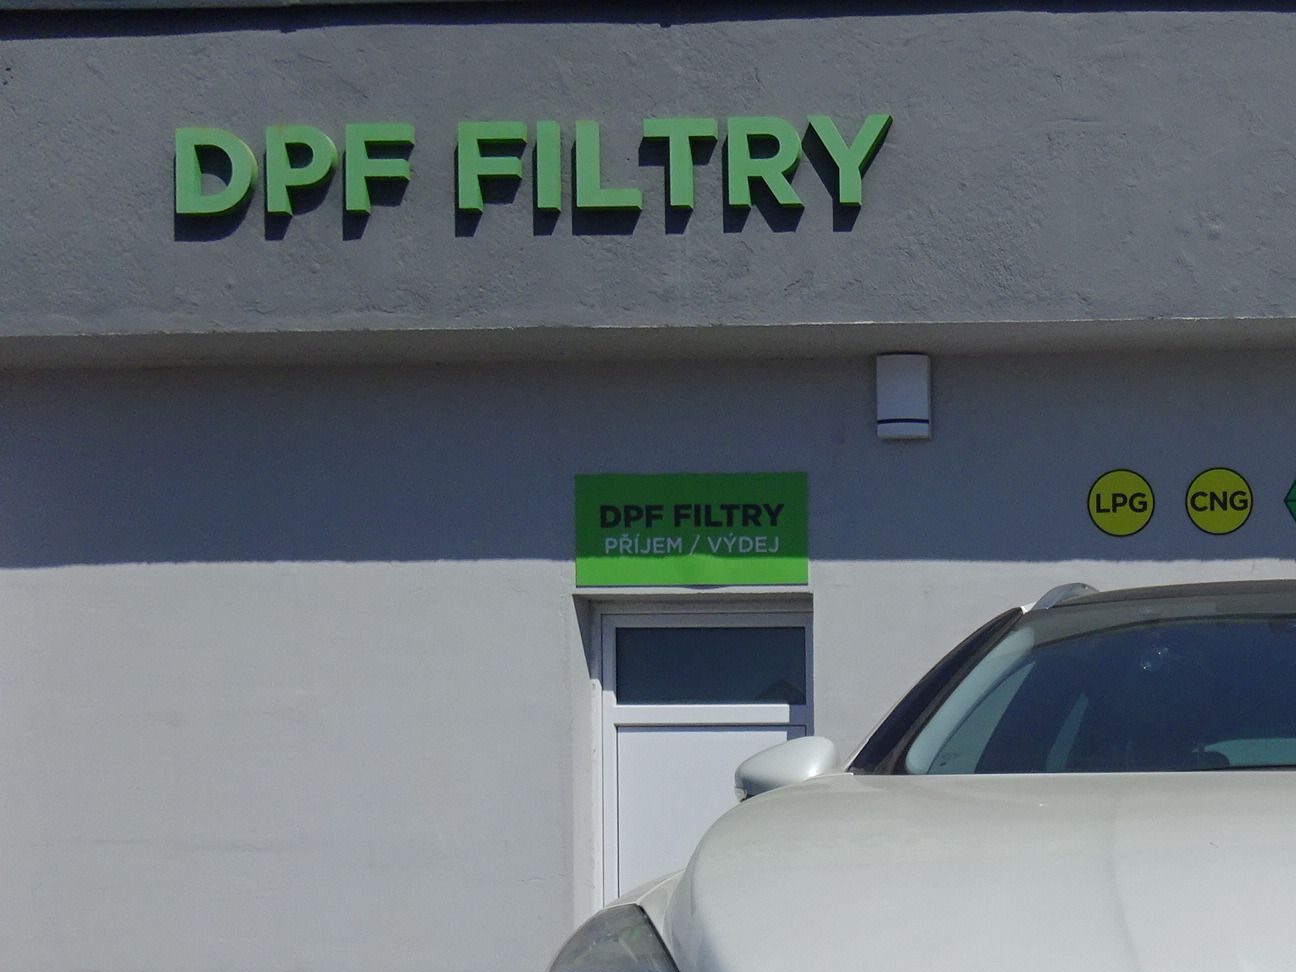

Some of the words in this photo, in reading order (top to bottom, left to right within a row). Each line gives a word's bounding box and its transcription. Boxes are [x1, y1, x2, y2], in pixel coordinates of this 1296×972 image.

[174, 122, 415, 218] DPF
[457, 113, 893, 213] FILTRY
[1095, 492, 1148, 514] LPG
[1189, 490, 1249, 512] CNG
[599, 504, 664, 529] DPF
[673, 502, 785, 528] FILTRY
[604, 533, 683, 555] PŘÍJEM
[688, 534, 701, 556] /
[707, 532, 780, 554] VÝDEJ
